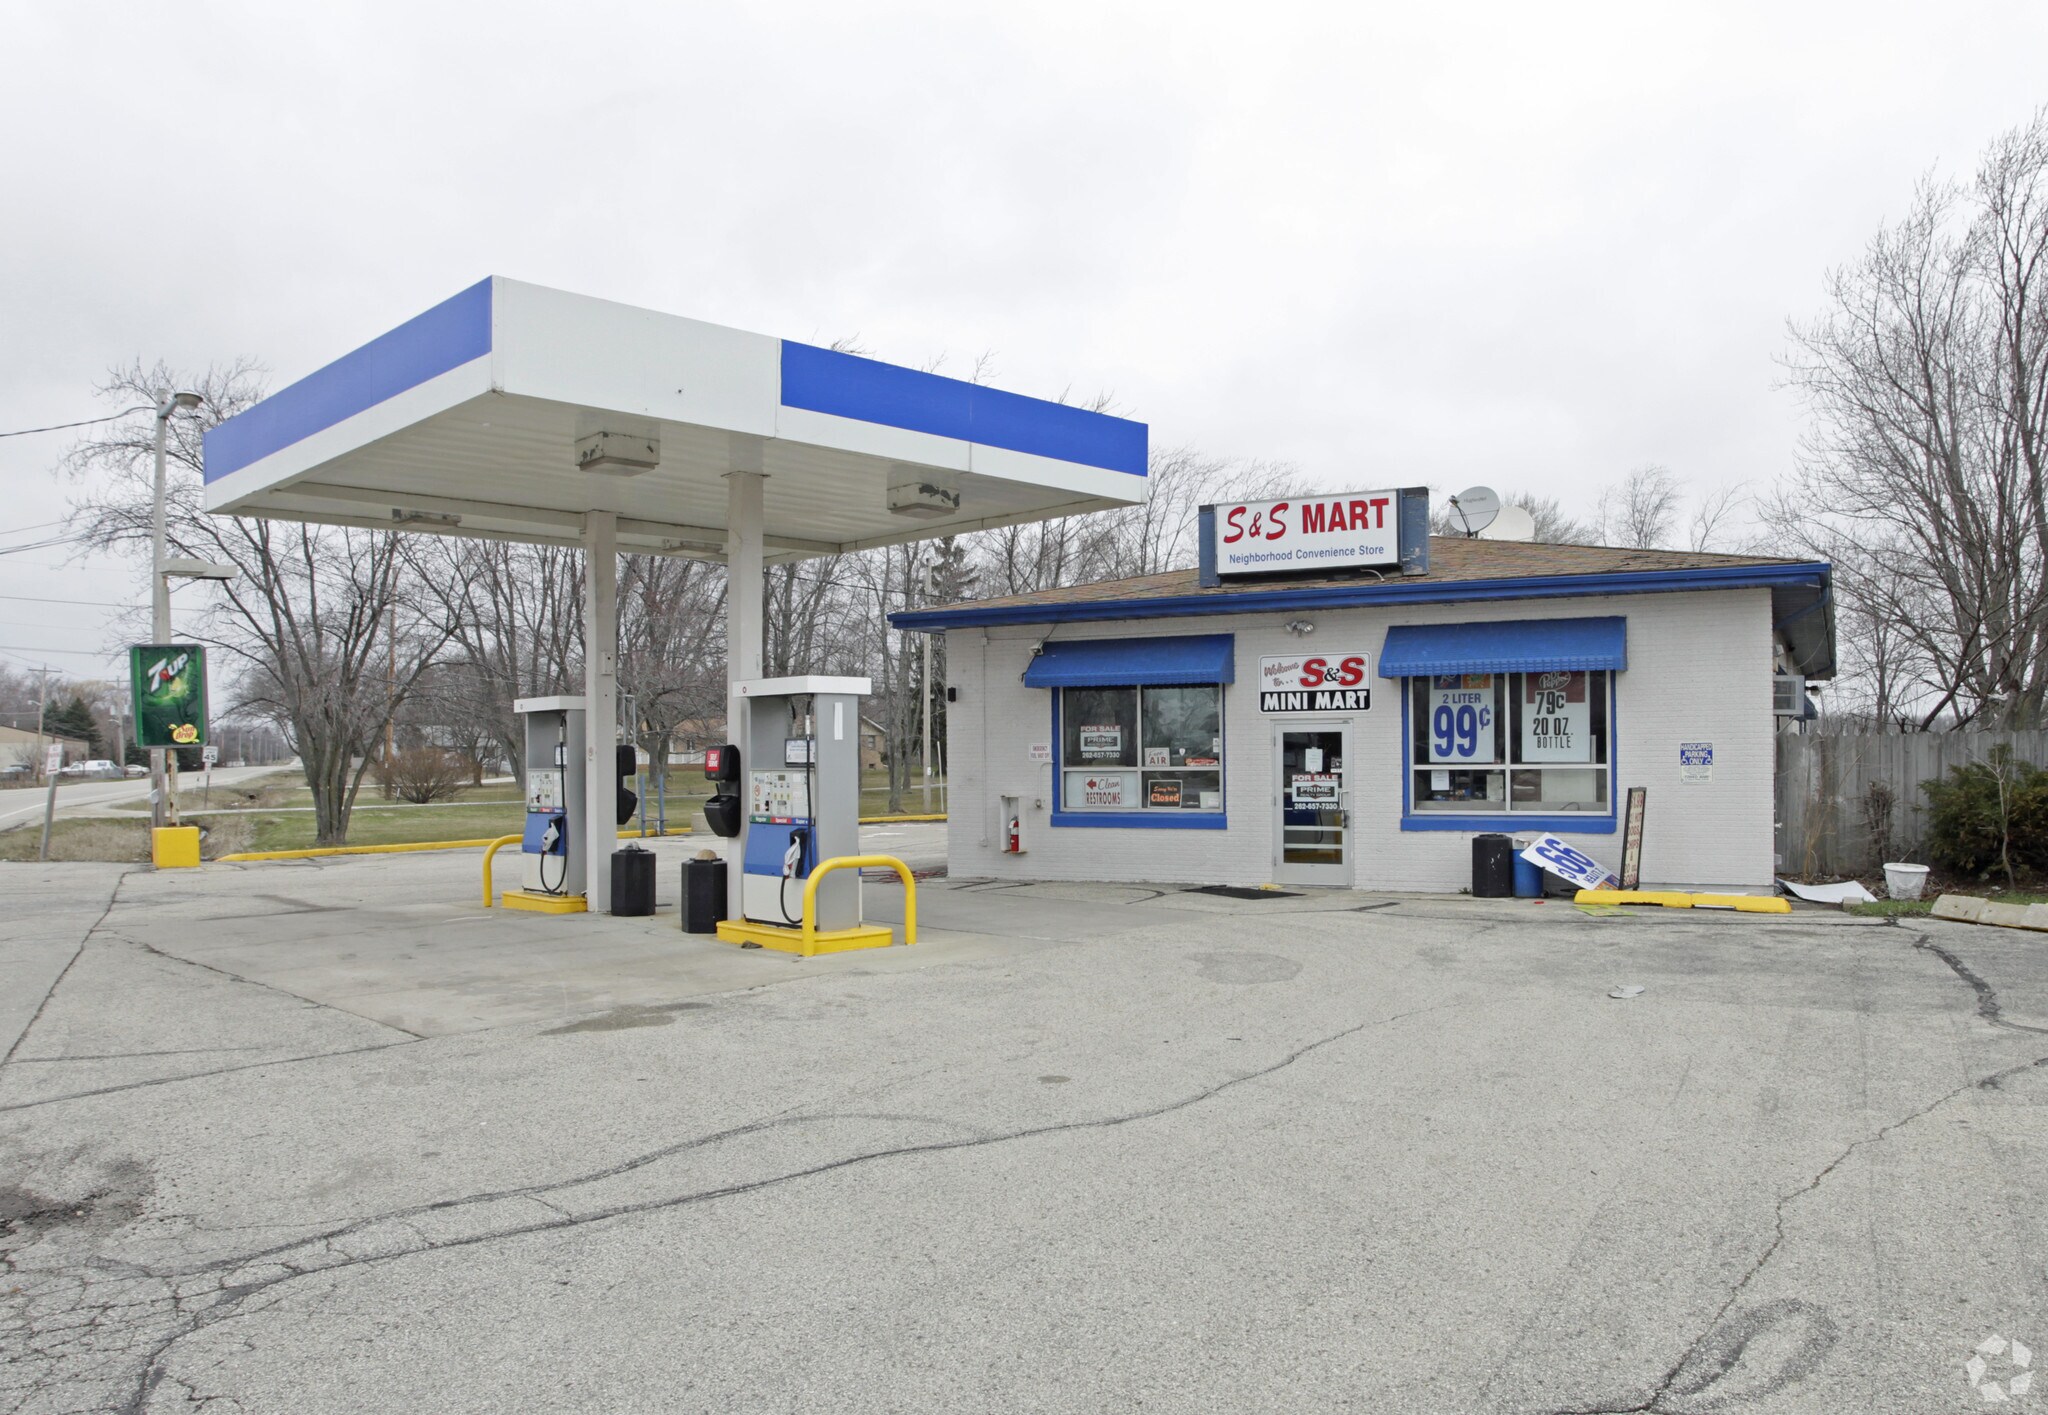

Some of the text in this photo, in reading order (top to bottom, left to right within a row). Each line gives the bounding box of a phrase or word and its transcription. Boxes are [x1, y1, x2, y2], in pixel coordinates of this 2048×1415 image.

[1224, 498, 1390, 544] S&S MART
[1230, 544, 1384, 565] Neighborhood Convenience Store
[1264, 662, 1300, 676] Welcome
[1299, 657, 1365, 687] S&S
[1264, 690, 1368, 710] MINI MART
[1442, 693, 1481, 704] 2 LITER
[1533, 718, 1548, 736] 20
[1536, 736, 1572, 748] BOTTLE
[1150, 756, 1166, 764] AIR
[1098, 778, 1120, 790] Clean
[1086, 792, 1120, 804] RESTROOMS
[1151, 793, 1180, 802] Closed
[1583, 870, 1602, 883] LITER
